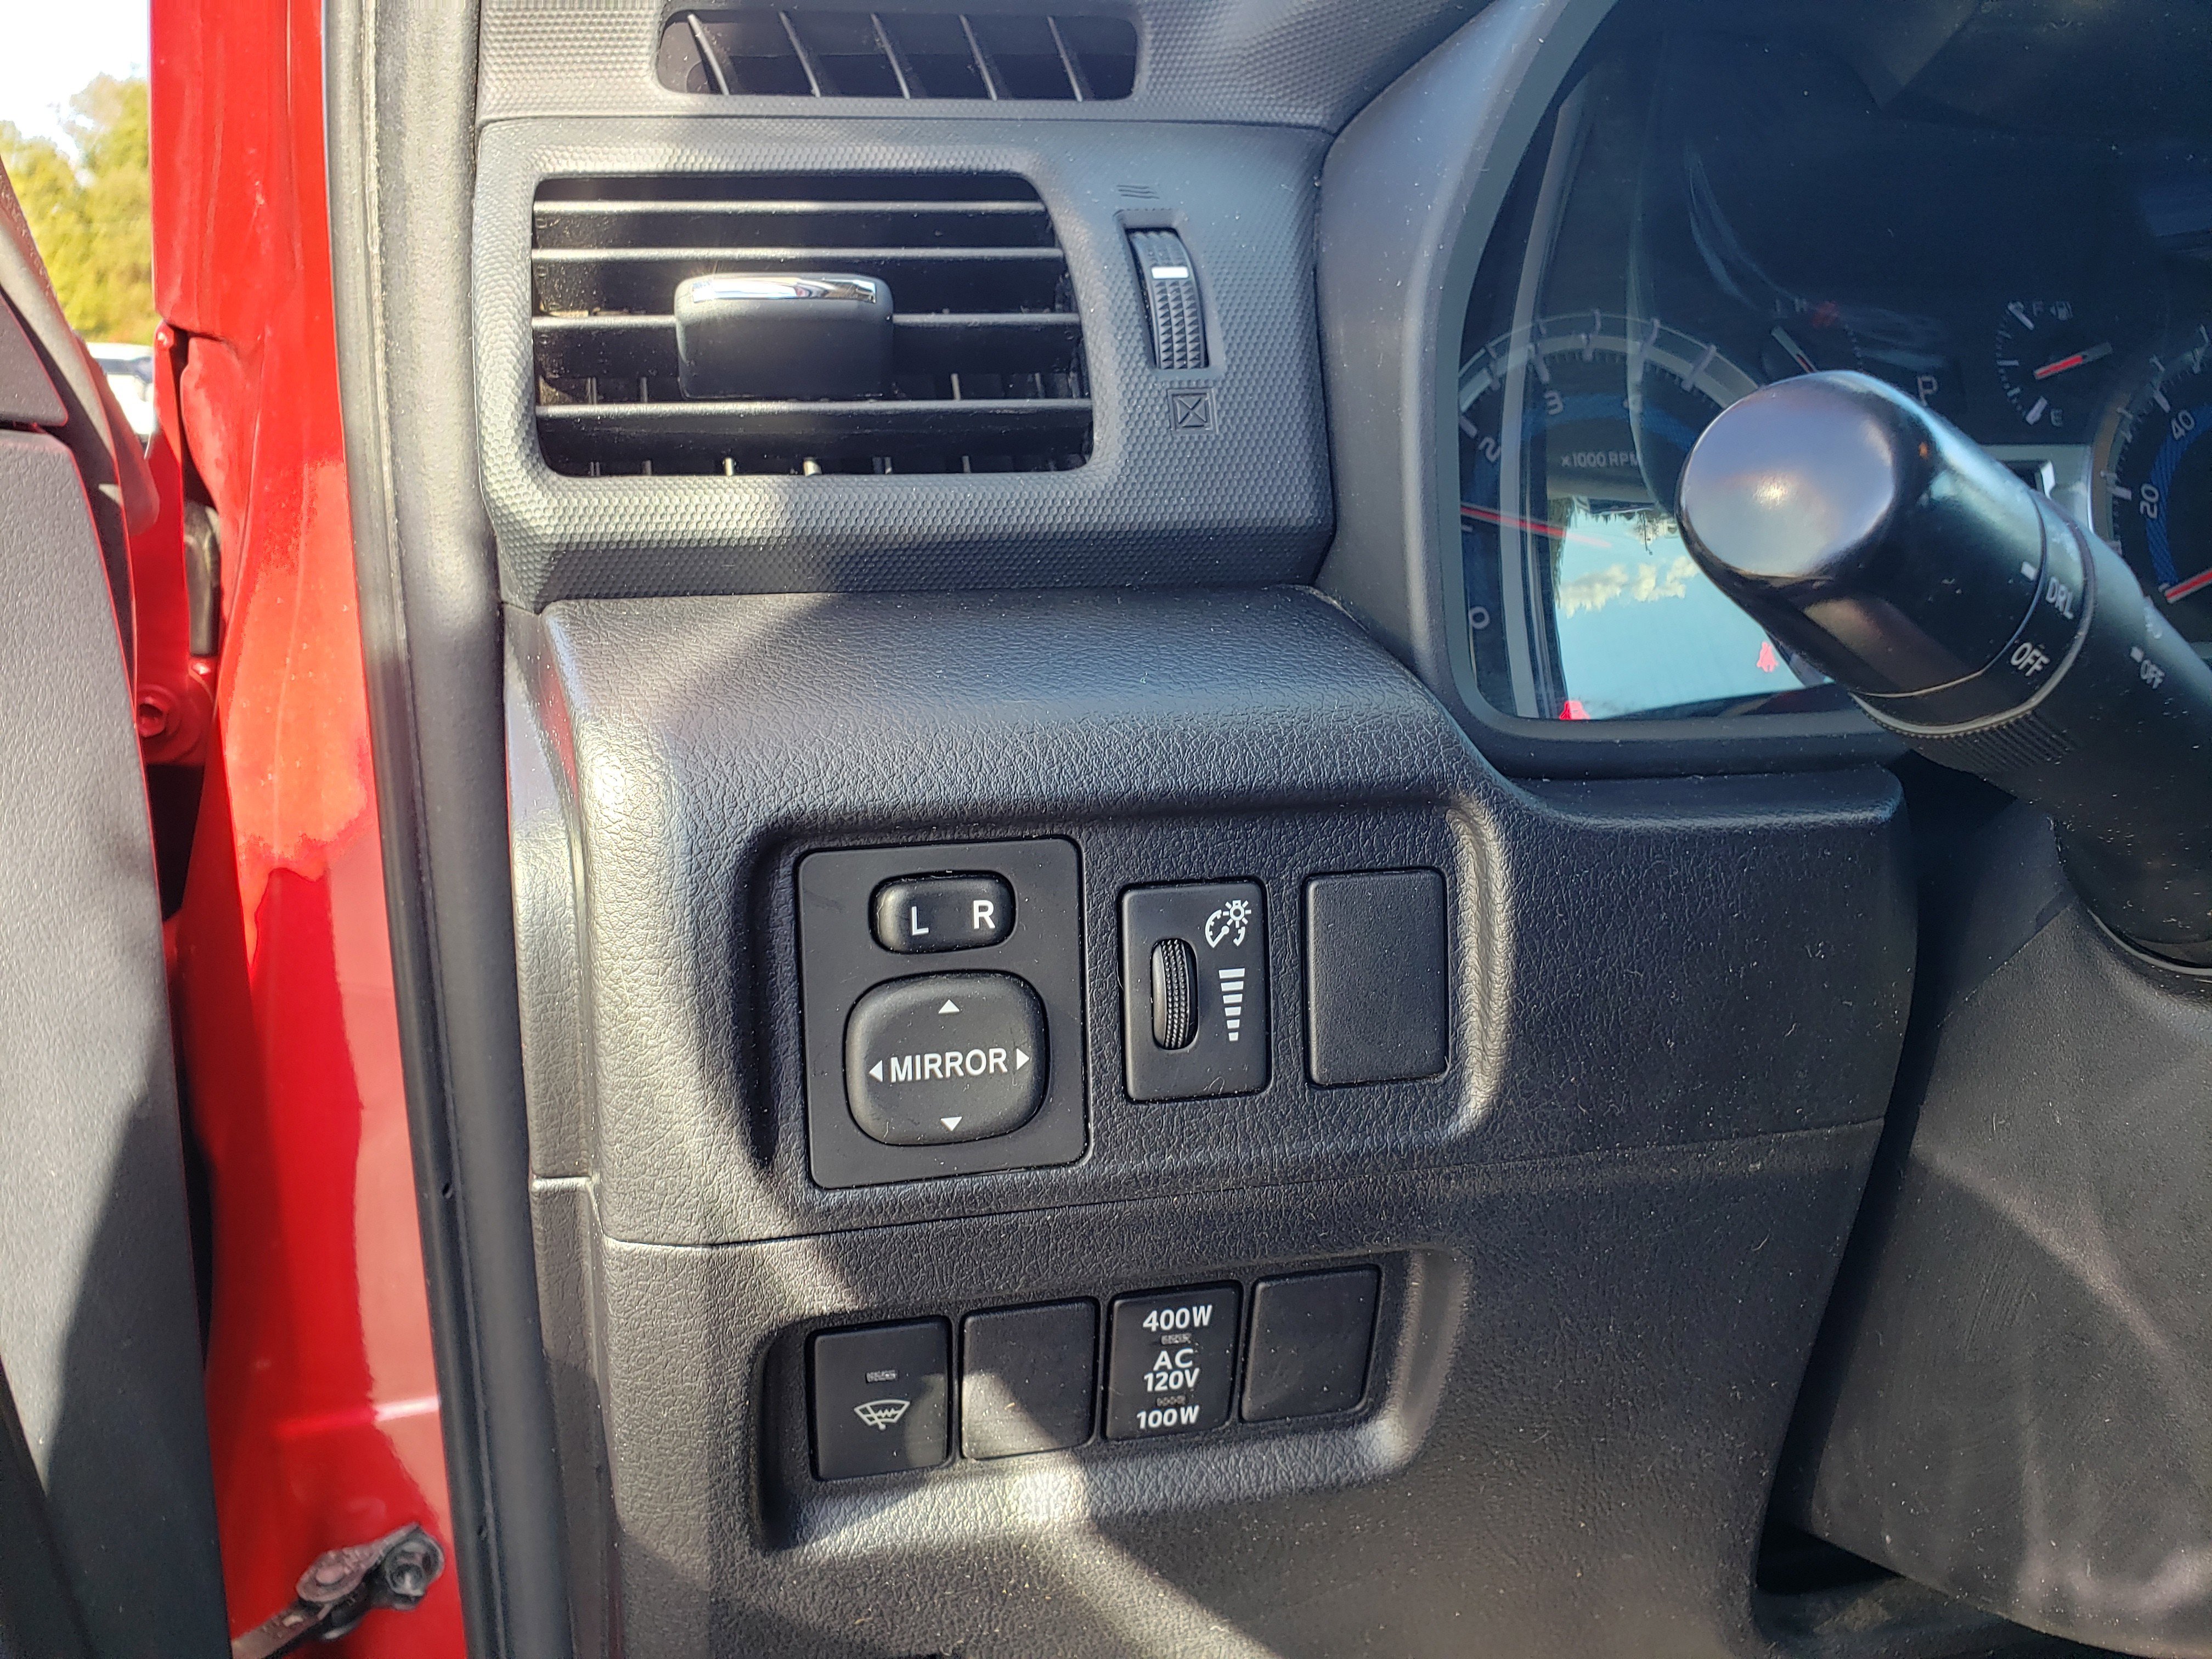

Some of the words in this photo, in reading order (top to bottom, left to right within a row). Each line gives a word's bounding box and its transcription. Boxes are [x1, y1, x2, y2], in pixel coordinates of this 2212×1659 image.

[1543, 390, 1564, 416] 3
[1916, 374, 1939, 407] P
[2050, 408, 2064, 427] E
[2170, 409, 2196, 441] 40
[1478, 437, 1502, 463] 2
[2140, 483, 2160, 519] 20
[2046, 576, 2074, 619] DRL
[1468, 606, 1490, 630] 0
[2010, 641, 2051, 677] OFF
[2140, 658, 2165, 689] OFF
[911, 906, 929, 936] L
[973, 900, 996, 930] R
[890, 1047, 1008, 1084] MIRROR
[1142, 1304, 1212, 1332] 400W
[1153, 1347, 1194, 1372] AC
[1143, 1367, 1200, 1392] 120V
[1136, 1404, 1200, 1430] 100W
